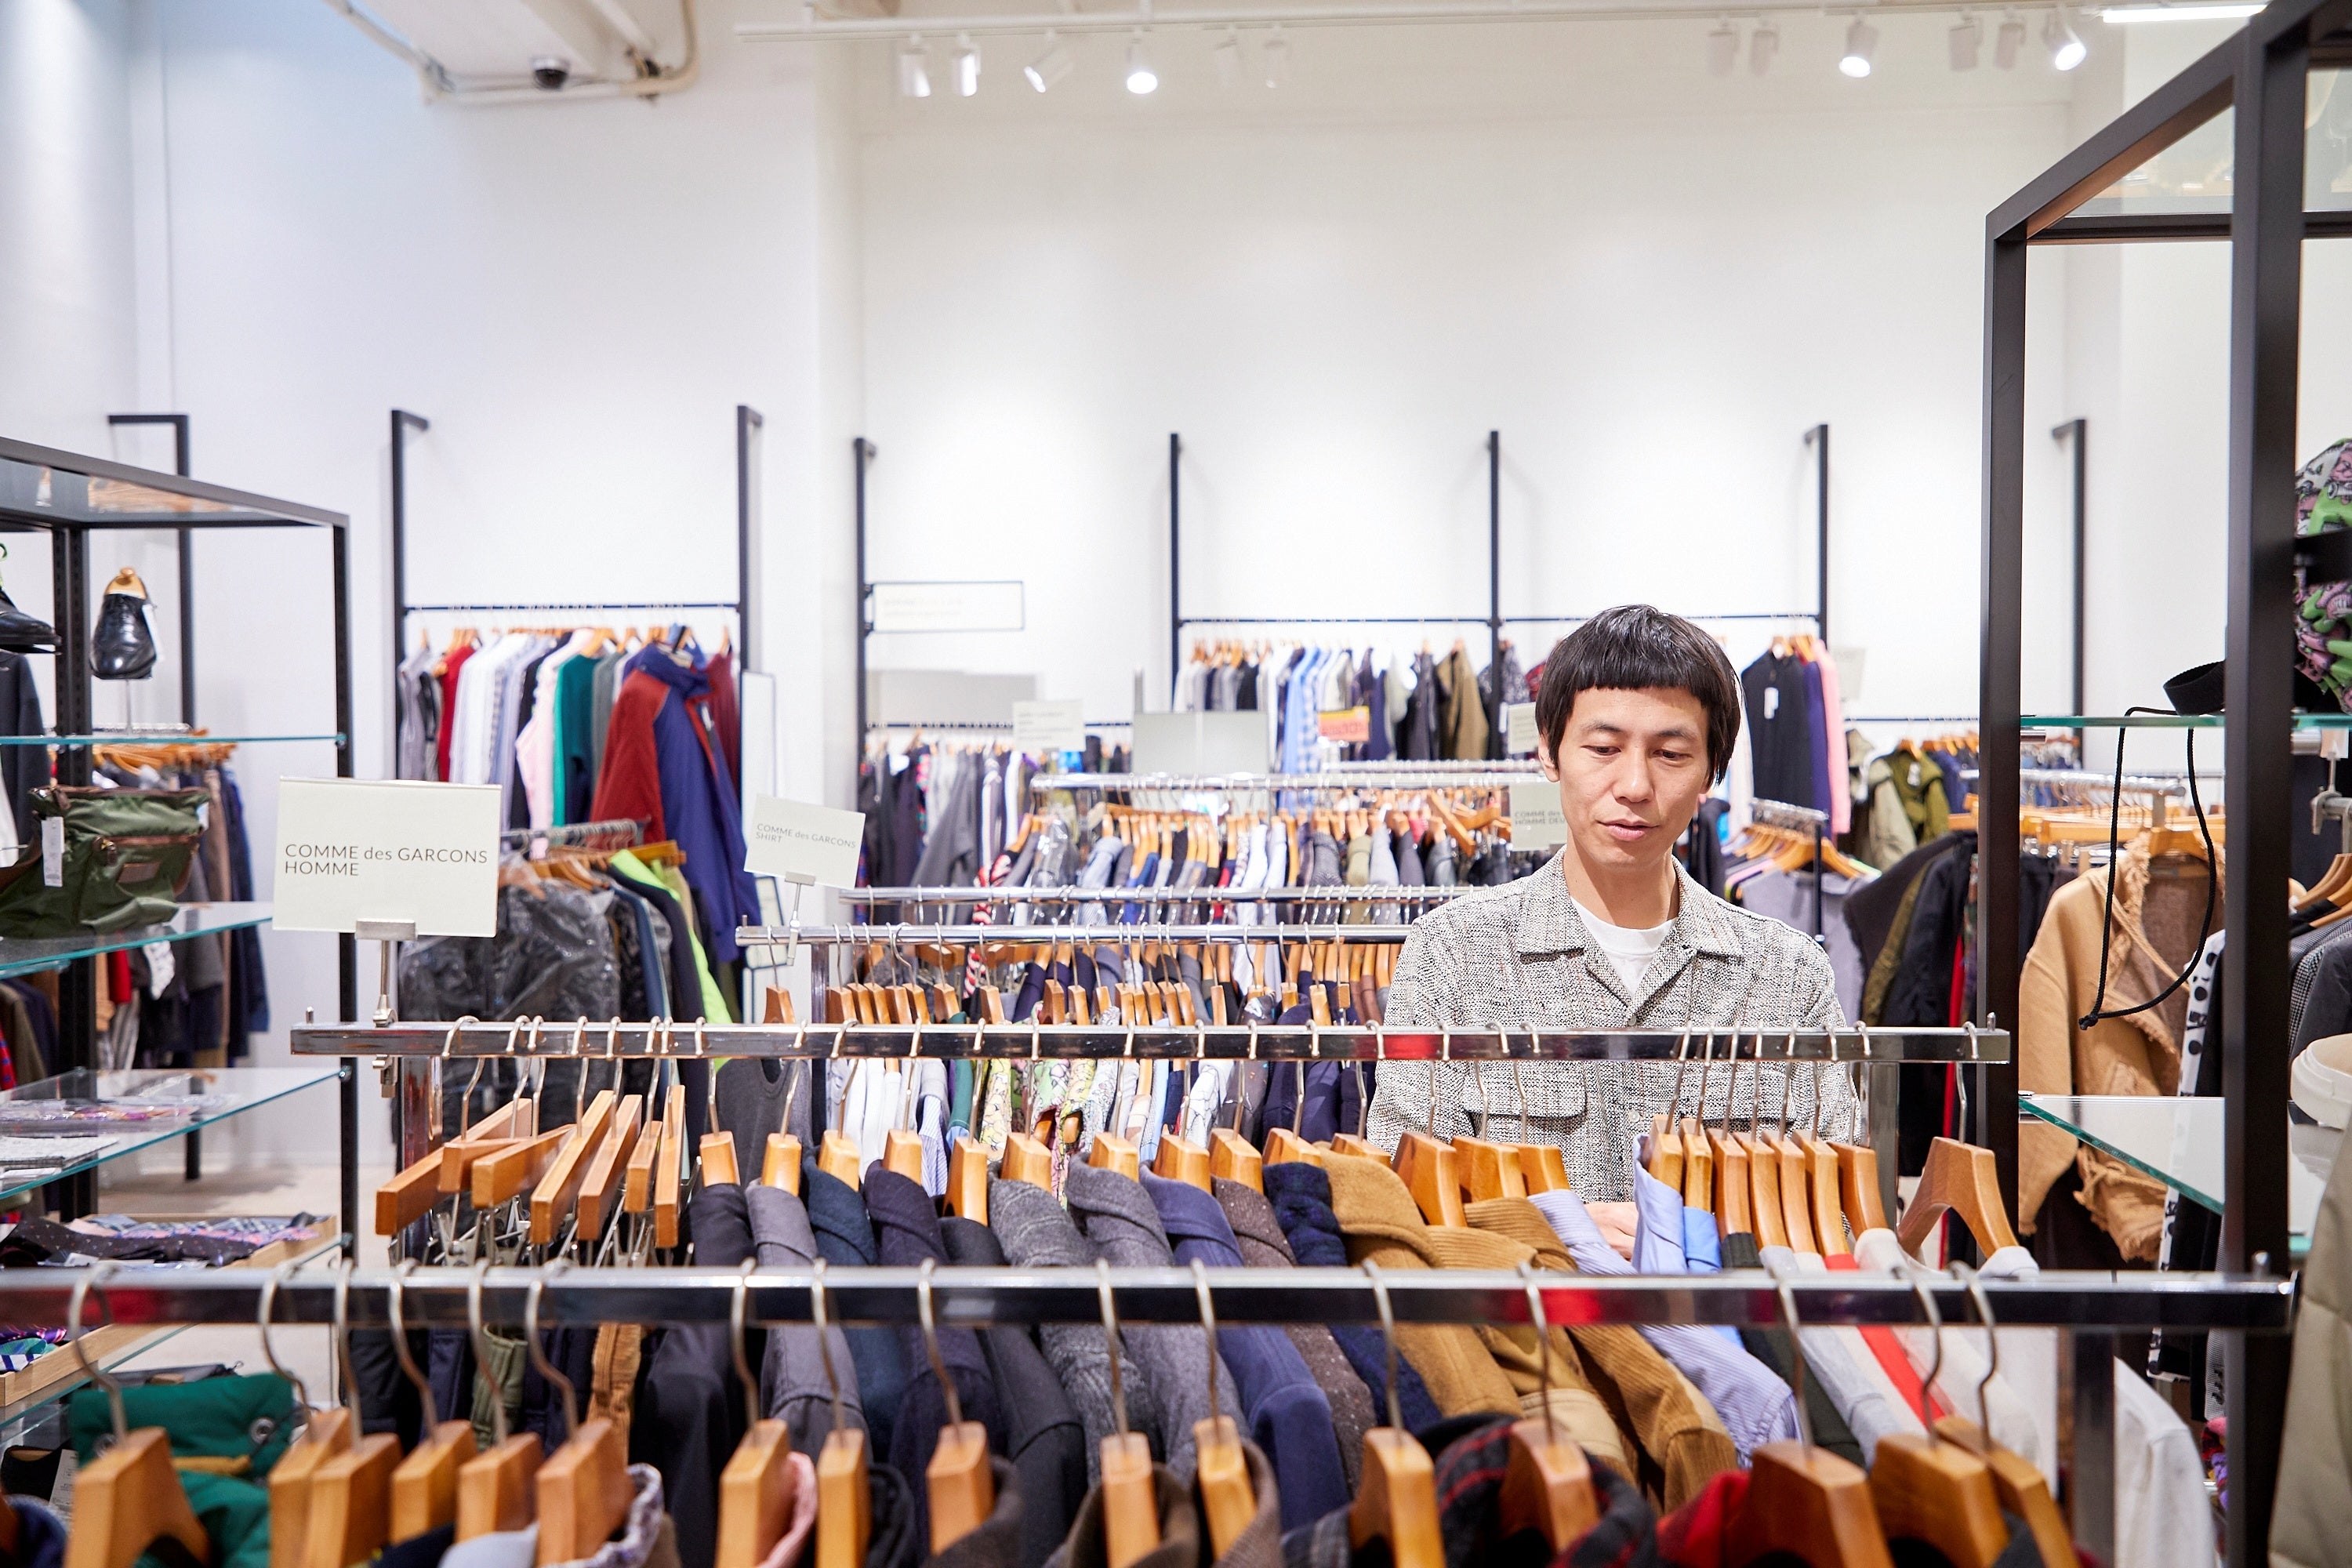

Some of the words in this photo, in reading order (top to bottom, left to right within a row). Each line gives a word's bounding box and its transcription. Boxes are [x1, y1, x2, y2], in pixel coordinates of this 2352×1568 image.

[756, 832, 783, 844] SHIRT
[757, 823, 793, 837] COMME
[795, 831, 809, 840] des
[811, 833, 856, 848] GARCONS
[285, 844, 359, 859] COMME
[364, 847, 392, 860] des
[397, 848, 488, 864] GARCONS
[285, 861, 359, 877] HOMME
